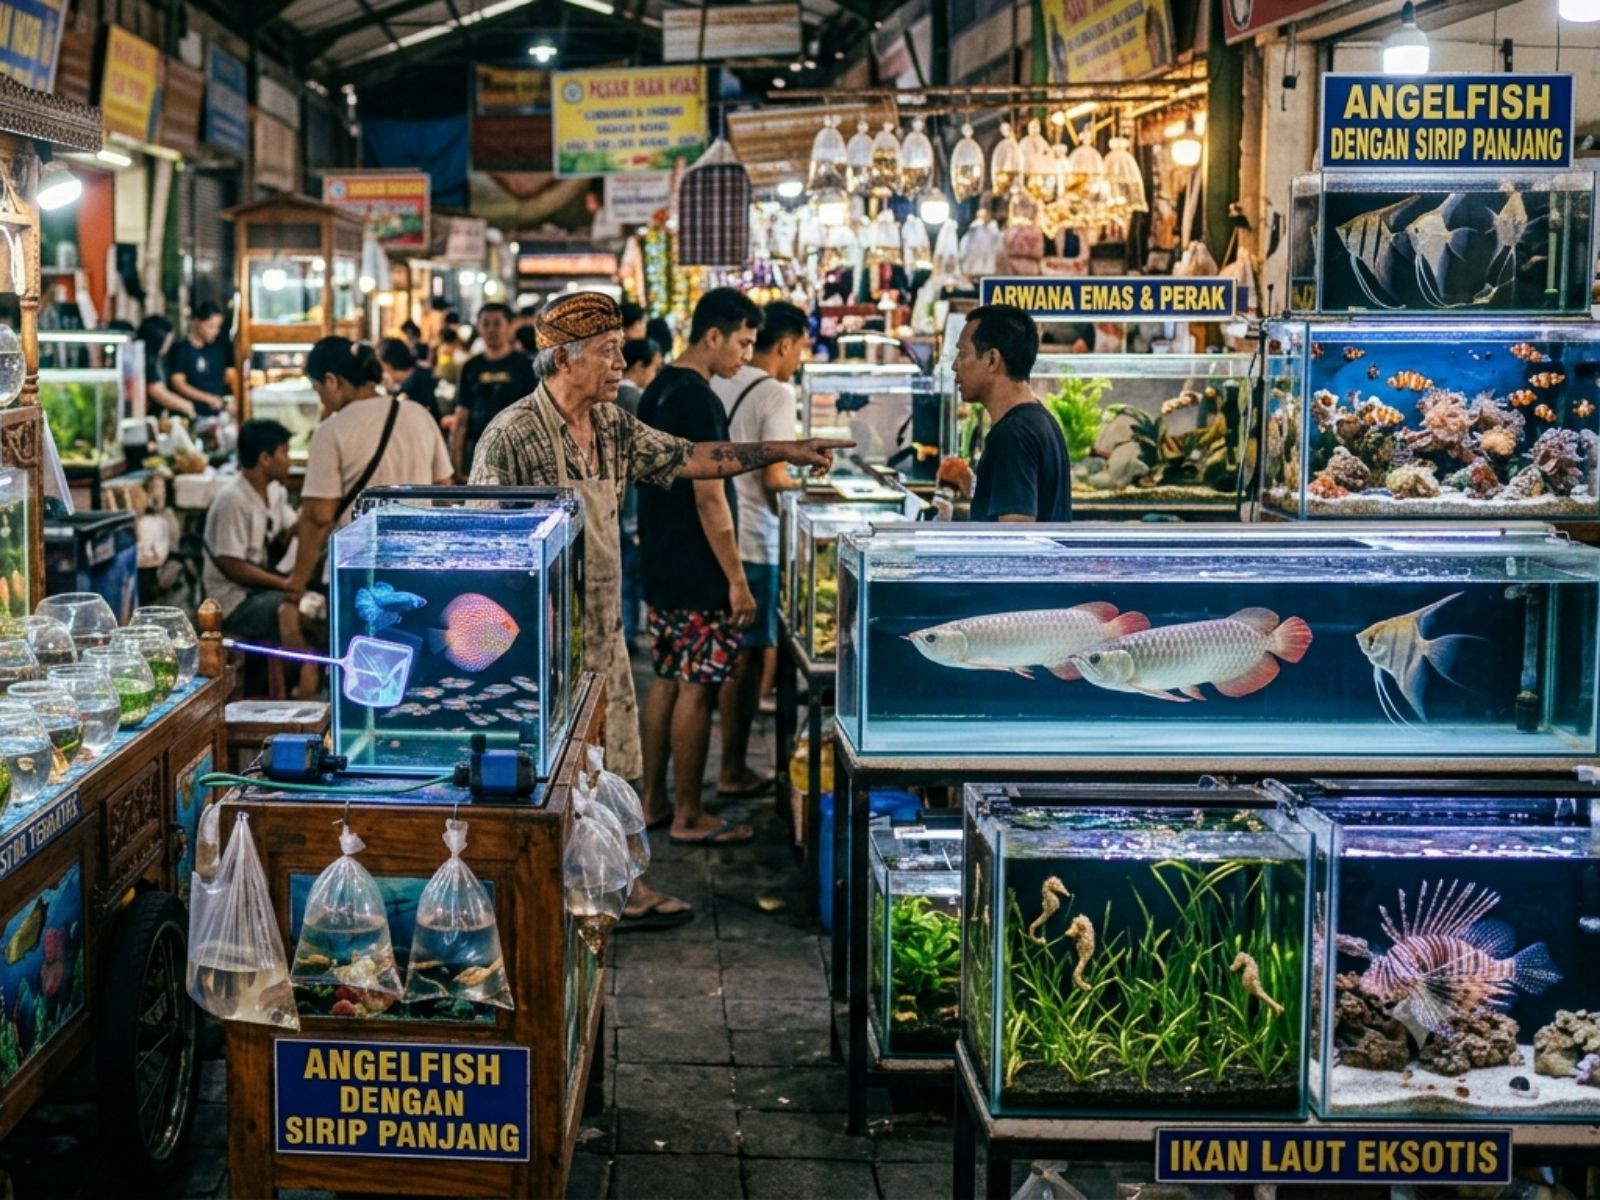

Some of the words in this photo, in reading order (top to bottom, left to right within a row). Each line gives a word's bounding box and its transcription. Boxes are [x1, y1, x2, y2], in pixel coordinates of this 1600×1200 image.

[1343, 84, 1550, 120] ANGELFISH
[1331, 128, 1409, 160] DENGAN
[1415, 128, 1467, 160] SIRIP
[1473, 128, 1563, 161] PANJANG
[991, 285, 1074, 311] ARWANA
[1080, 286, 1134, 311] EMAS
[1140, 286, 1154, 310] &
[1160, 286, 1226, 311] PERAK
[304, 1048, 500, 1086] ANGELFISH
[340, 1086, 464, 1117] DENGAN
[285, 1115, 368, 1146] SIRIP
[379, 1119, 520, 1152] PANJANG
[1170, 1140, 1248, 1171] IKAN
[1261, 1140, 1346, 1172] LAUT
[1357, 1140, 1498, 1173] EKSOTIS
